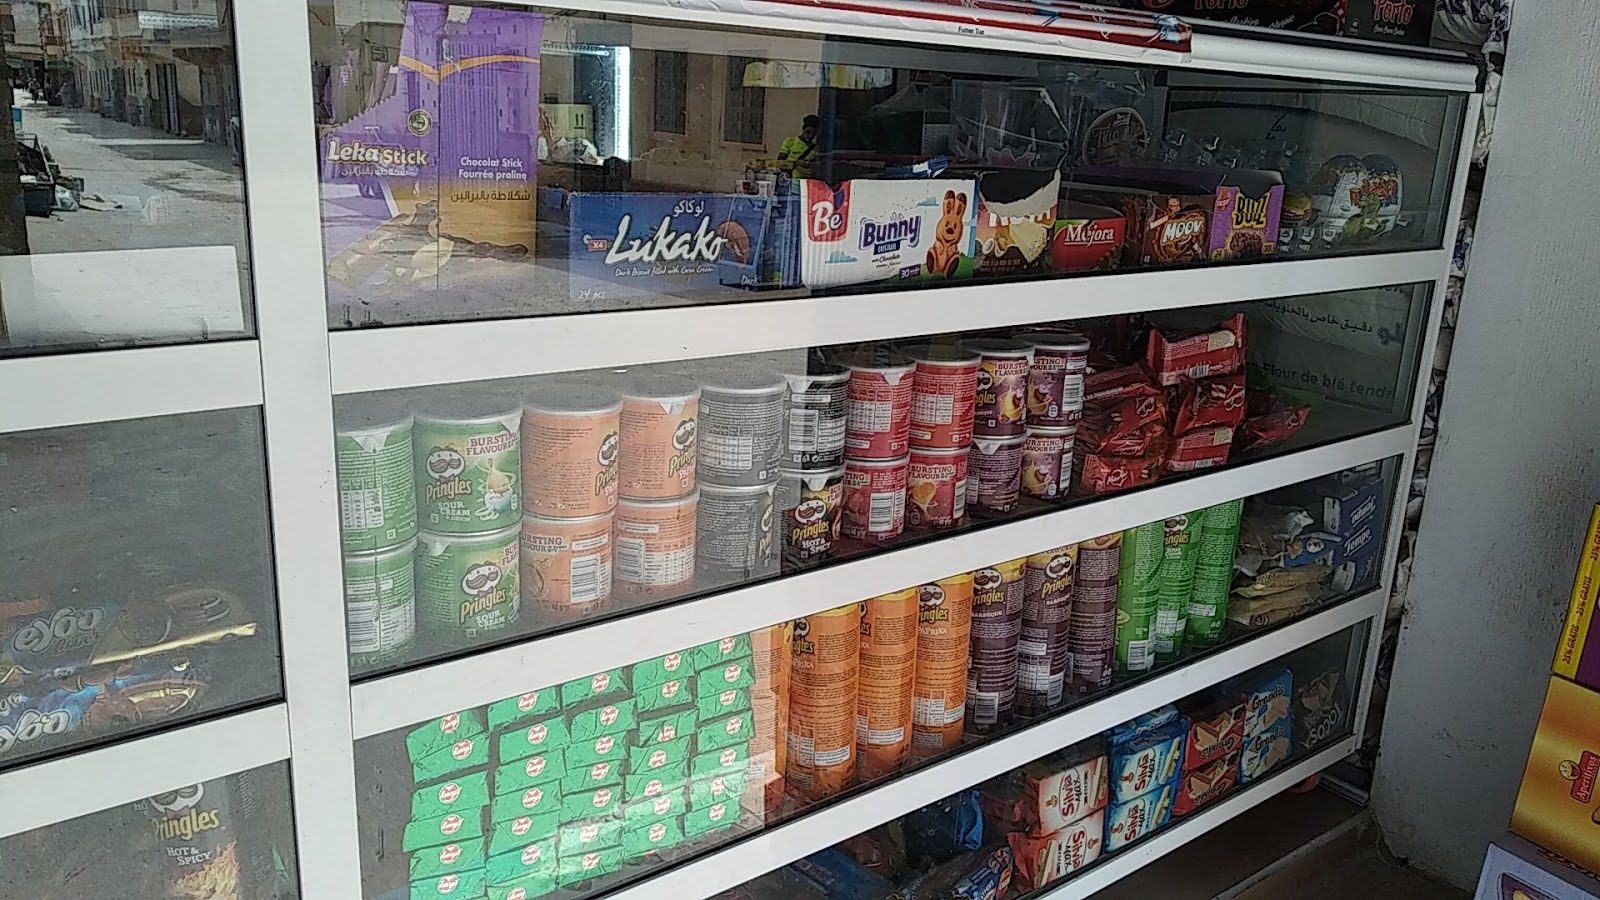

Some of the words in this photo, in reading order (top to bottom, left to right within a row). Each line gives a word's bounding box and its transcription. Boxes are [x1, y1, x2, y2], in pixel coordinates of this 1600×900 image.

[958, 25, 974, 35] Fumer
[974, 28, 984, 36] Tue
[327, 139, 381, 162] Leka
[382, 147, 427, 166] Stick
[460, 157, 499, 168] Chocolat
[502, 157, 523, 168] Stick
[458, 168, 494, 180] Fourrée
[495, 169, 528, 181] praline
[673, 199, 705, 217] لوكاكو
[811, 200, 842, 237] Be
[604, 214, 728, 265] Lukako
[862, 215, 921, 248] Bunny
[1064, 223, 1115, 248] Mejora
[740, 274, 759, 286] Dark
[577, 289, 591, 300] 24
[1301, 371, 1319, 385] de
[1323, 374, 1346, 391] blé
[425, 479, 472, 505] Pringles
[791, 519, 830, 546] Pringles
[802, 539, 819, 549] HOT
[809, 541, 832, 555] SPICY
[1041, 574, 1073, 599] Pringles
[458, 587, 507, 625] Pringles
[1062, 774, 1075, 817] Silvia
[151, 808, 221, 841] Pringles
[166, 847, 189, 857] HOT
[177, 851, 213, 866] SPICY
[1072, 829, 1086, 870] Silvia
